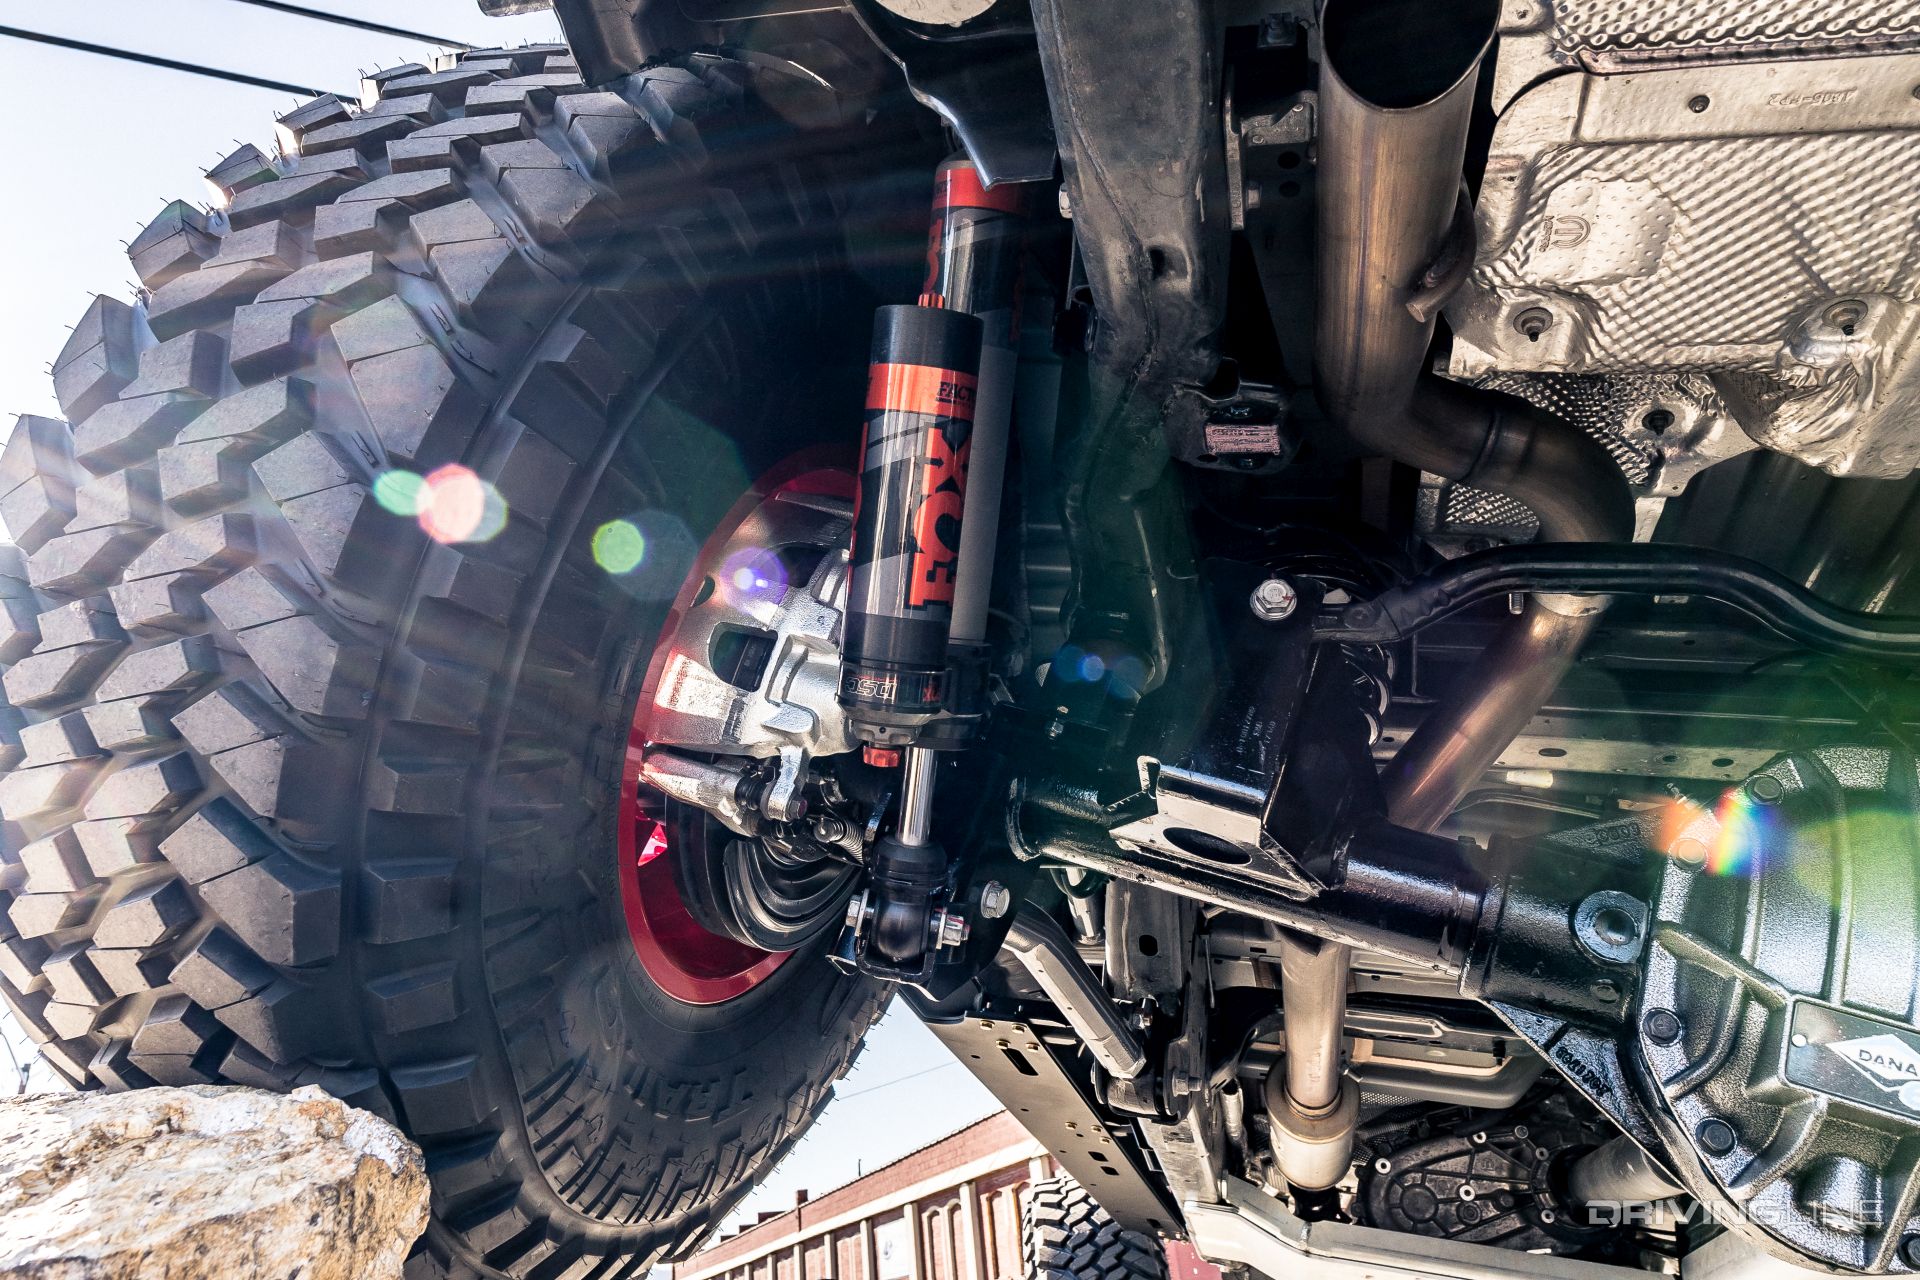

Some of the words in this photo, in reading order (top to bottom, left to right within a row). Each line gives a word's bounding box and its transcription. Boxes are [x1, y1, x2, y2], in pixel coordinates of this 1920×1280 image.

[907, 424, 974, 607] FOX
[845, 677, 898, 701] DSC
[1858, 1048, 1918, 1077] DANA
